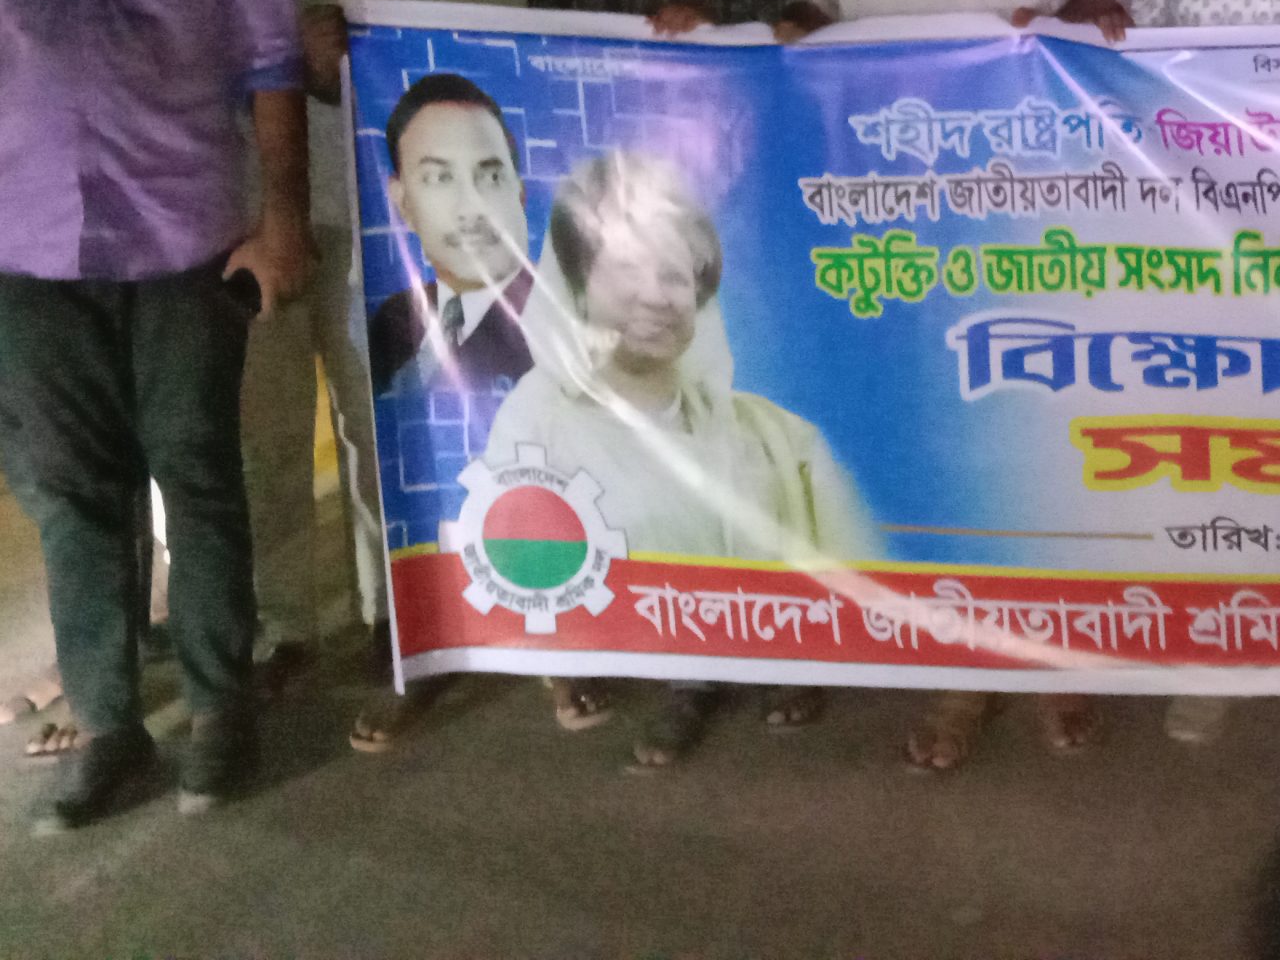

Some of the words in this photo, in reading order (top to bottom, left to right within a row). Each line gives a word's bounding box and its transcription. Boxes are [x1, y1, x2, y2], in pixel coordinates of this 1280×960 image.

[852, 100, 974, 164] শহীদ
[802, 171, 939, 224] বাংলাদেশ
[946, 160, 1129, 214] জাতীয়তাবাদী
[1137, 177, 1183, 214] দল
[945, 245, 977, 296] ও
[982, 226, 1108, 298] জাতীয়
[1114, 244, 1222, 294] সংসদ
[626, 580, 844, 646] বাংলাদেশ
